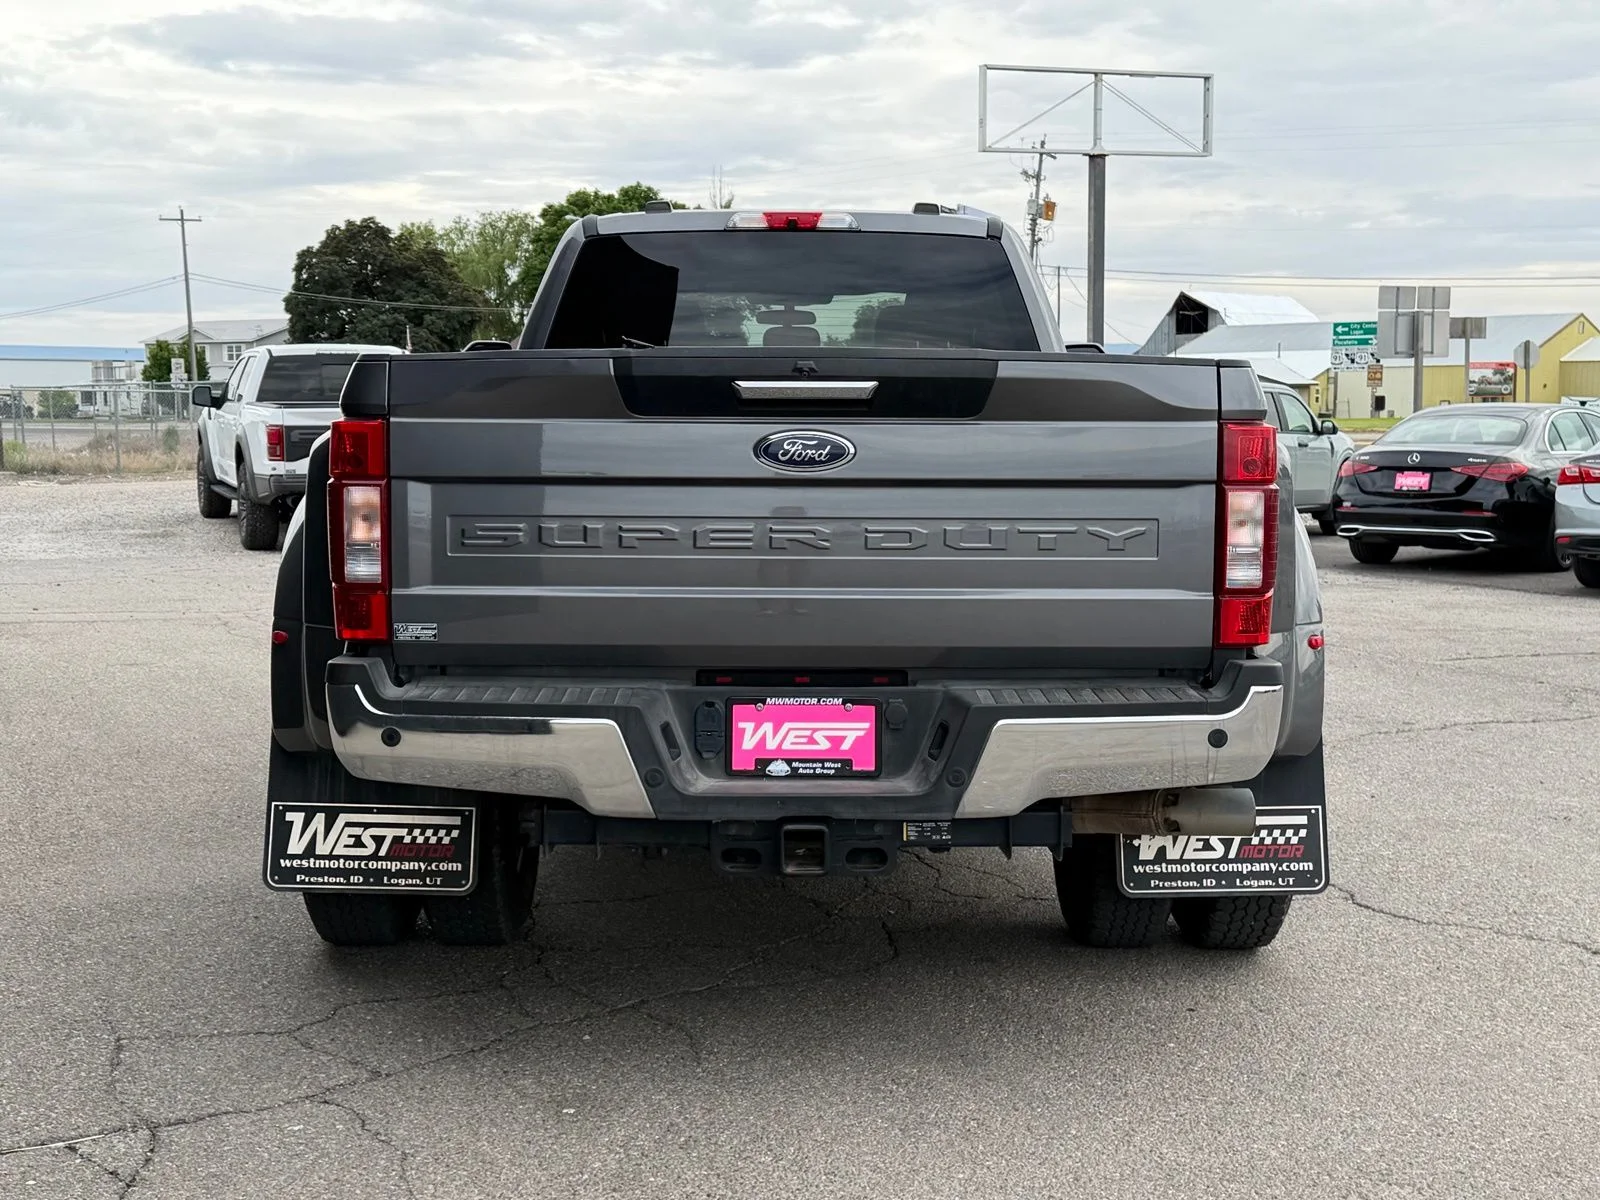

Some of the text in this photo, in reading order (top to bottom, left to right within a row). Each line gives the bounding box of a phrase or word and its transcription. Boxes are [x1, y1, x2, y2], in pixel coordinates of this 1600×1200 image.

[778, 439, 831, 461] Ford
[461, 523, 1149, 552] SUPER DUTY
[766, 697, 843, 706] MWMOTOR.COM
[738, 722, 870, 750] WEST
[285, 811, 461, 857] WEST
[390, 843, 455, 858] MOTOR
[1239, 844, 1305, 858] MOTOR
[280, 857, 462, 873] westmotorcompany.com
[1133, 861, 1314, 874] westmotorcompany.com
[296, 874, 347, 884] Preston,
[383, 876, 424, 886] Logan,
[426, 877, 444, 885] UT
[1150, 878, 1296, 889] Preston, ID Logan, UT
